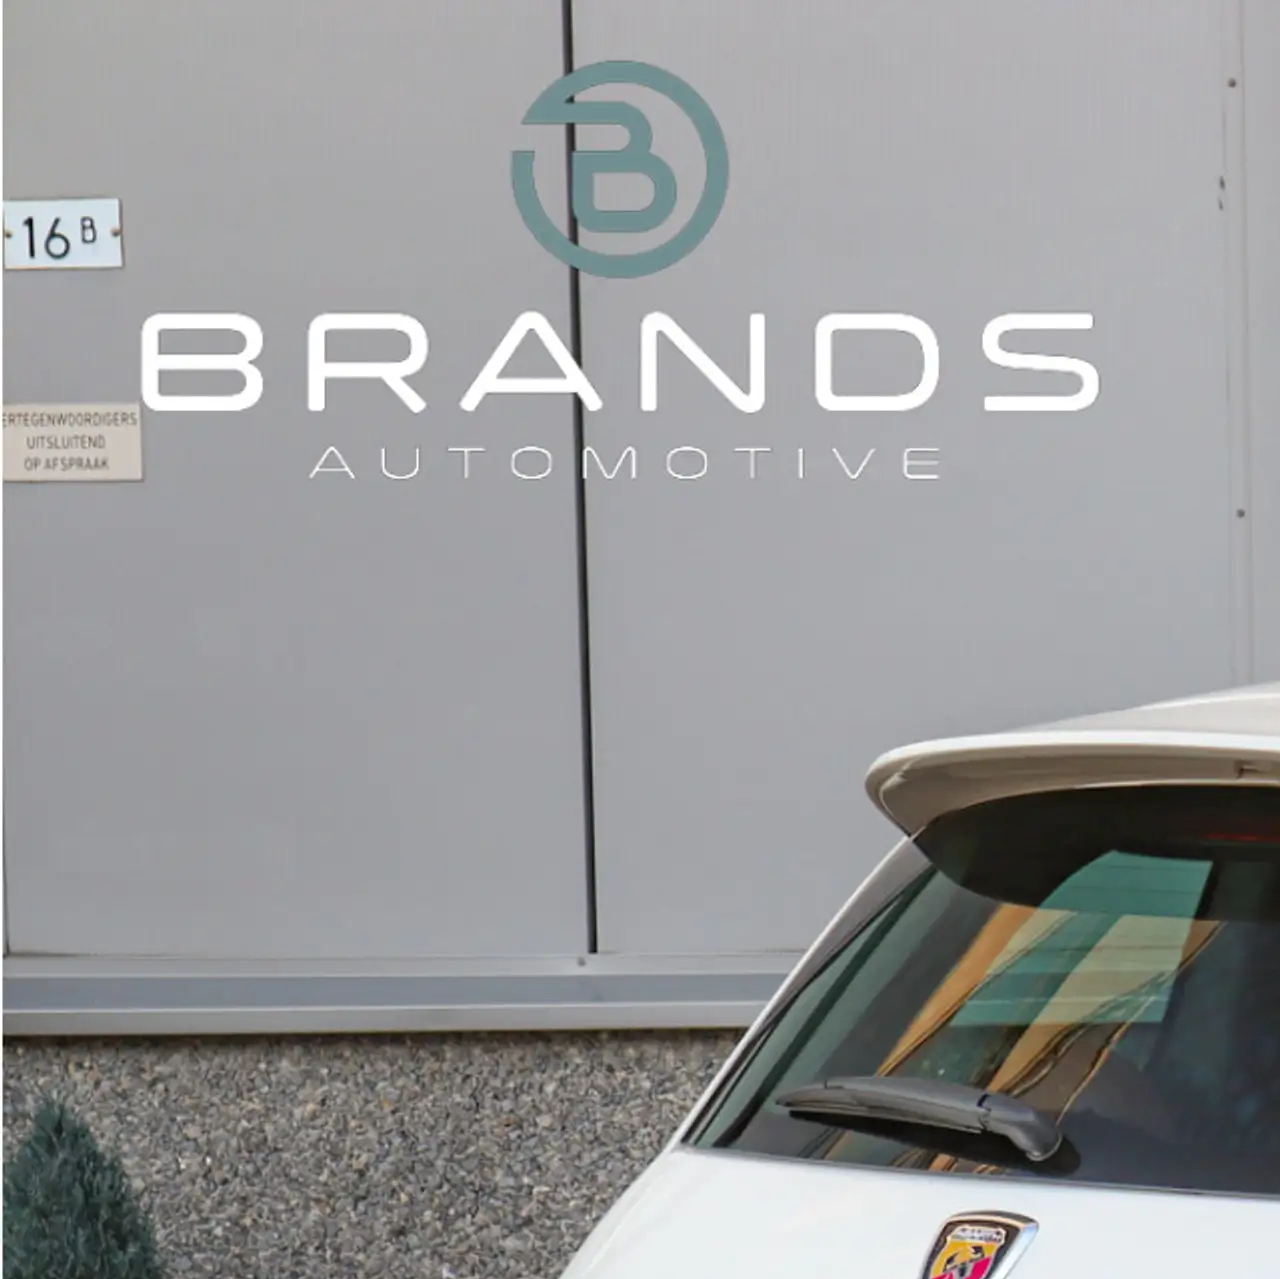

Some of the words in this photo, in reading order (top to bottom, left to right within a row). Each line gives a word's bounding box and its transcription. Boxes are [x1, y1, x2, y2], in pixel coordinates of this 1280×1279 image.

[26, 434, 106, 450] UITSLUITEND
[24, 457, 41, 472] OP
[43, 456, 110, 472] AFSPRAAK
